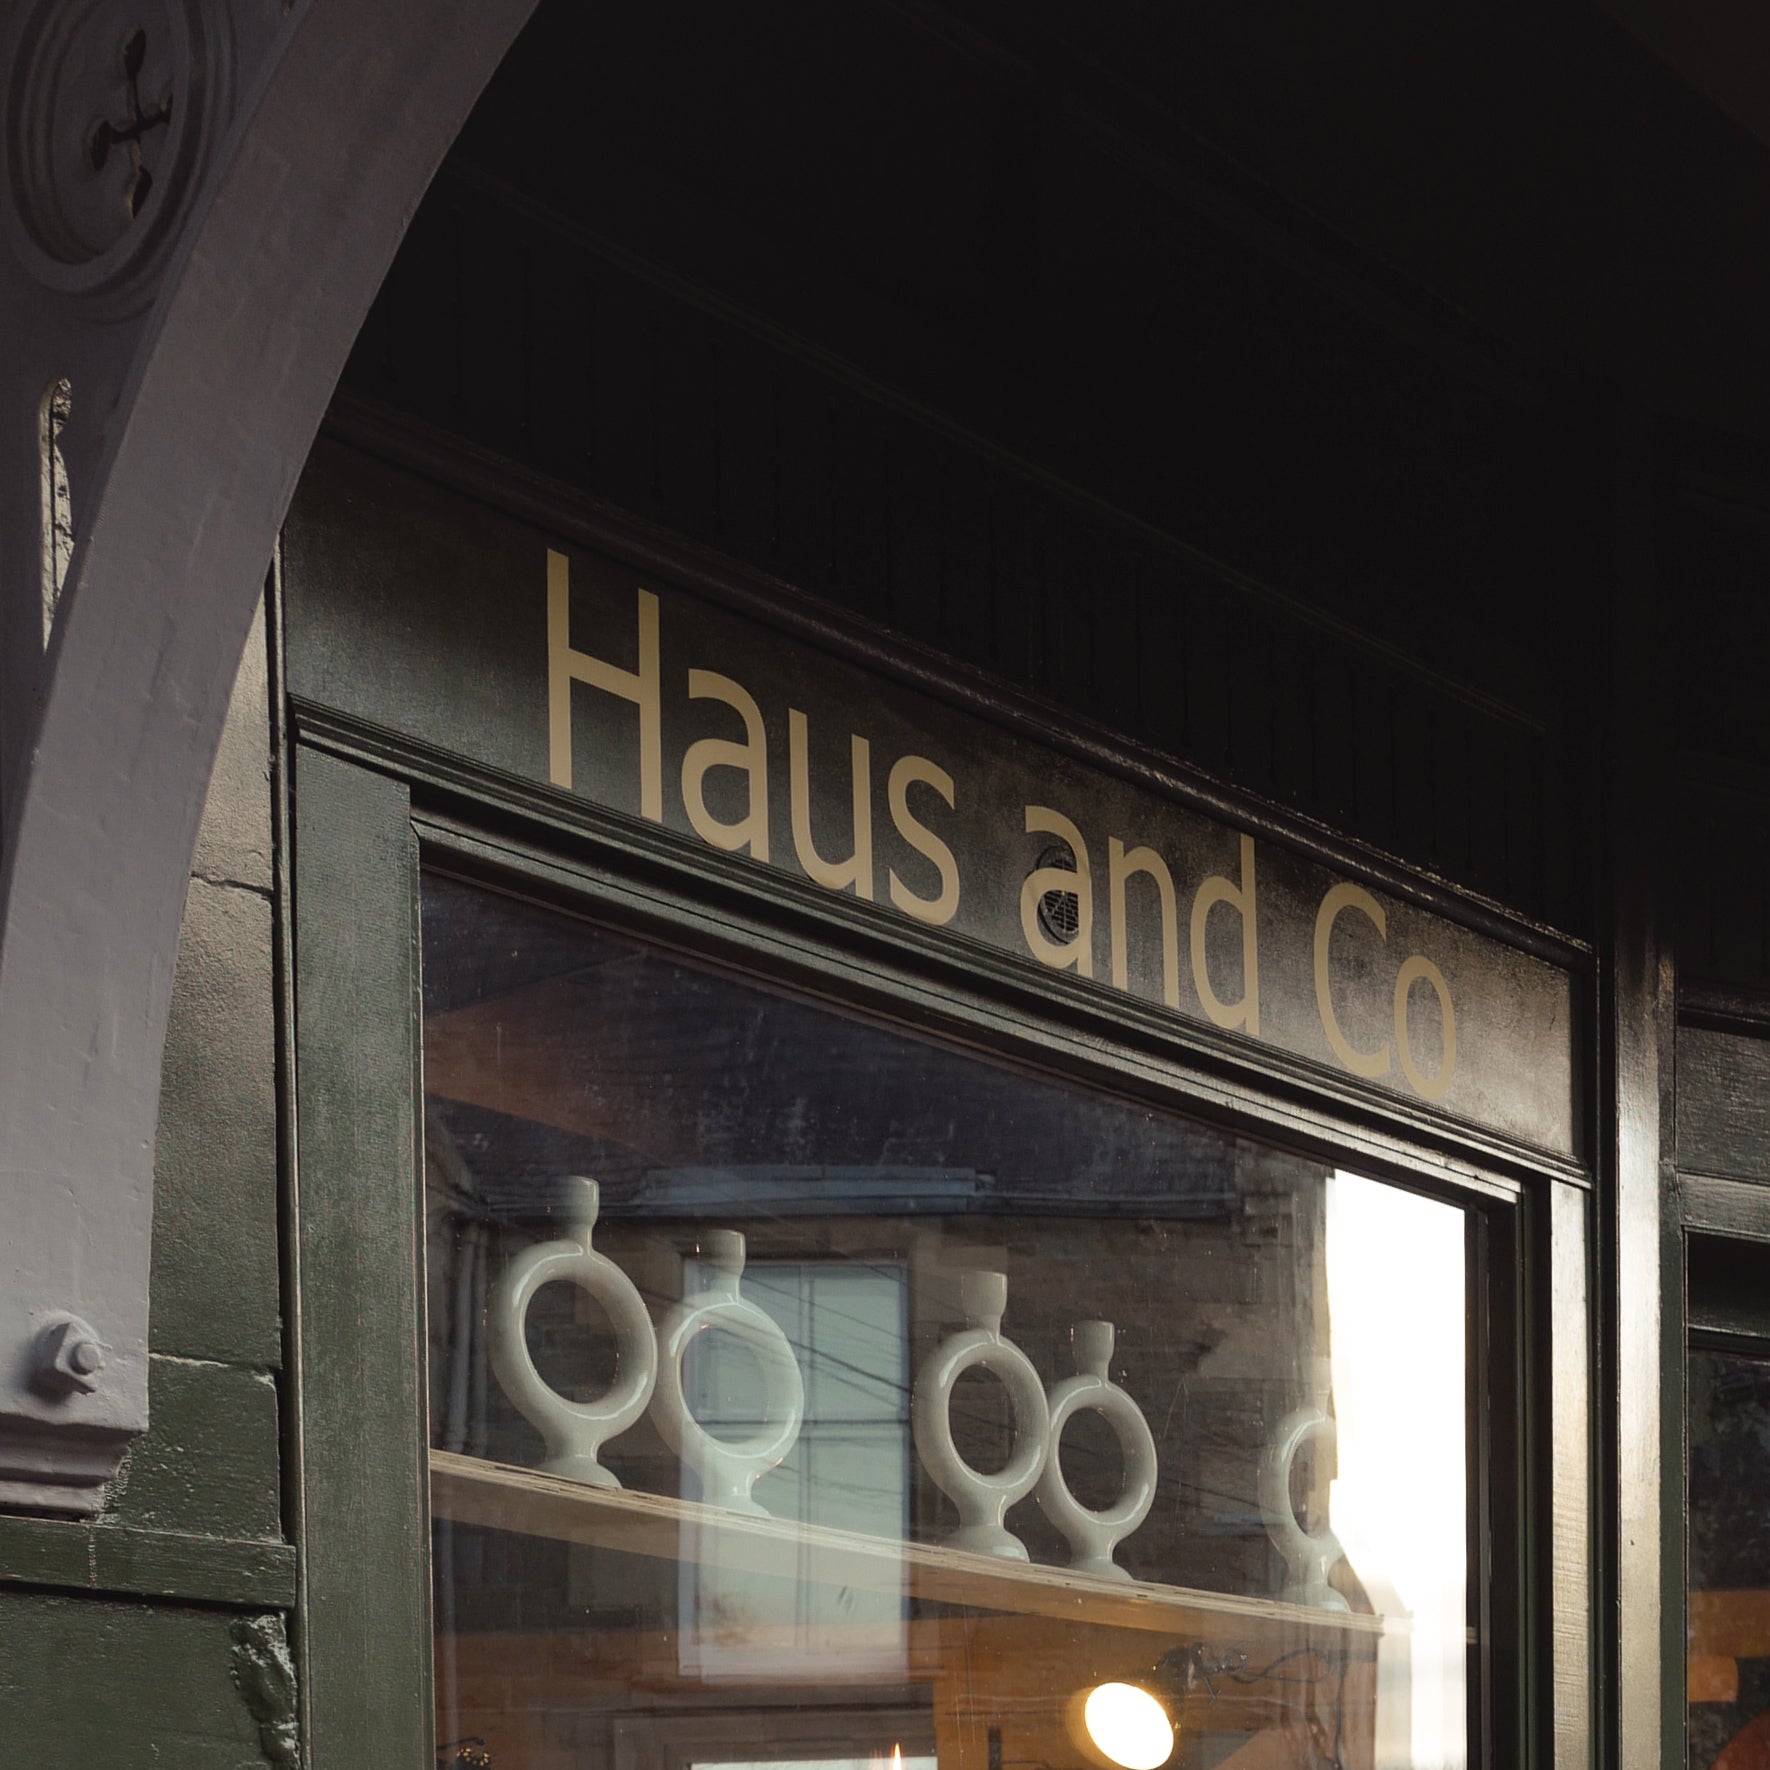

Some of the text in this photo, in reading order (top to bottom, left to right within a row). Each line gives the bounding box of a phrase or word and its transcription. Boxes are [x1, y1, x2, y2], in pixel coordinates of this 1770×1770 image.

[546, 548, 1456, 1100] Haus and Co
